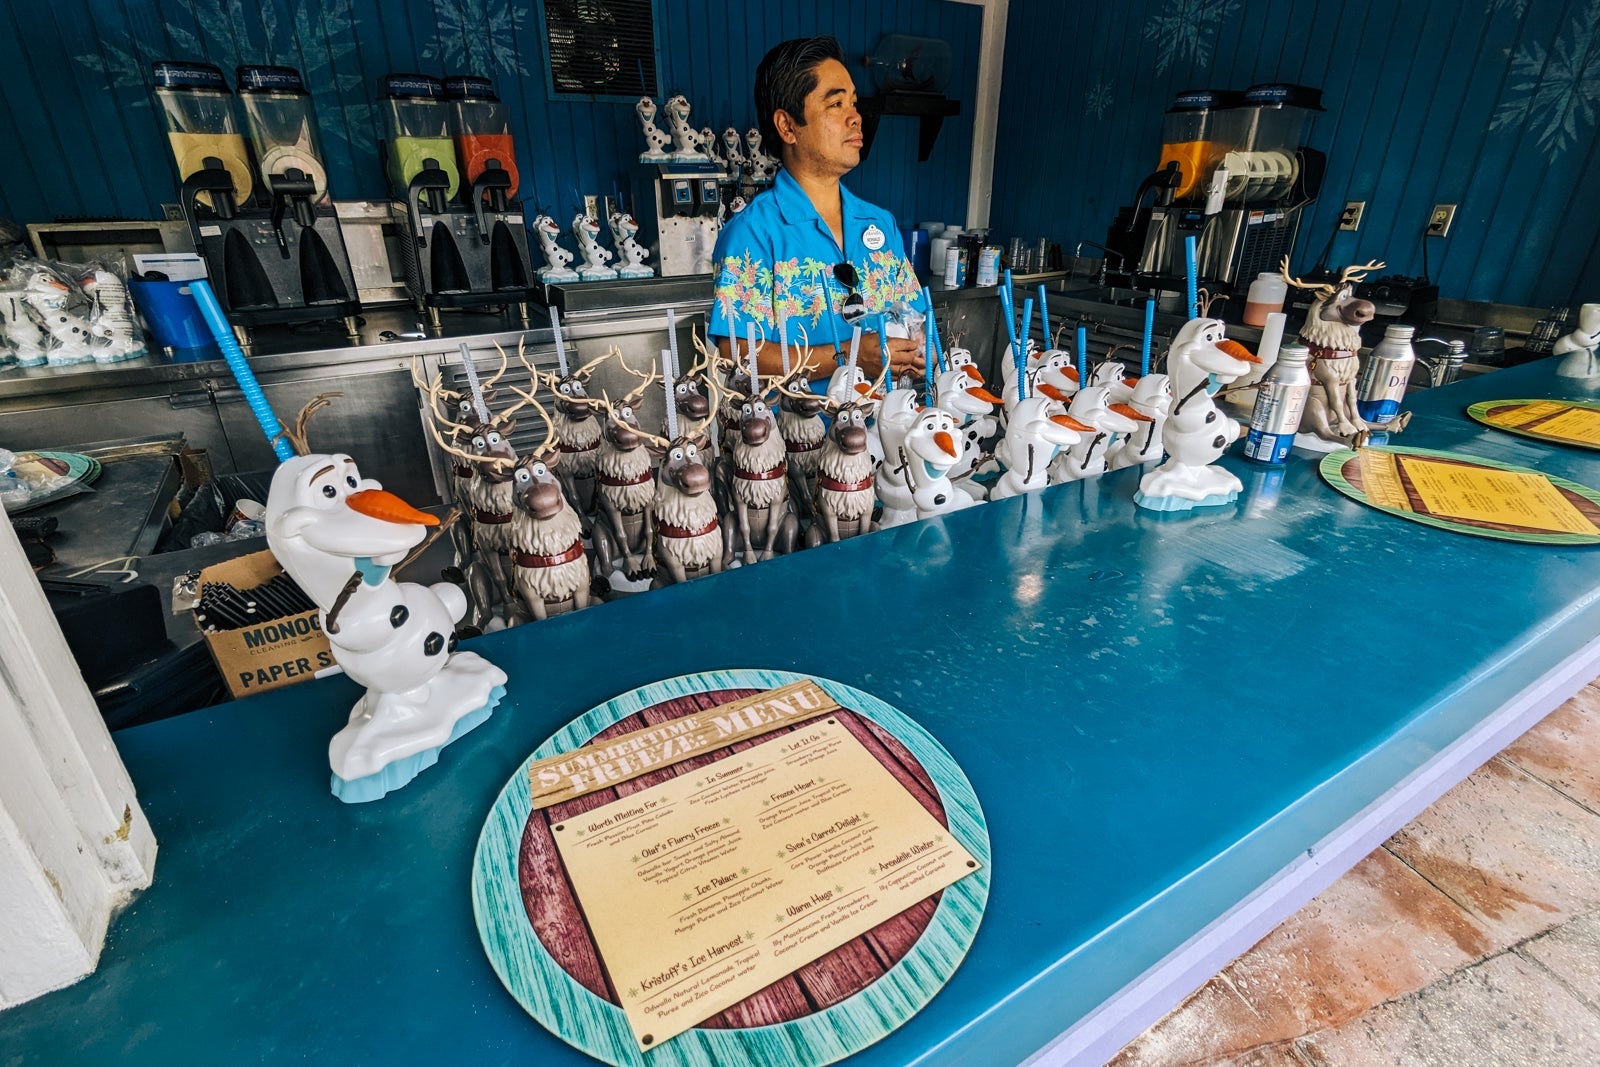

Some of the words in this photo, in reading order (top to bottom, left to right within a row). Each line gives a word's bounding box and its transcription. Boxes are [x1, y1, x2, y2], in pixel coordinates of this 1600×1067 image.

[250, 640, 297, 655] CLEANING
[240, 657, 312, 688] PAPER
[316, 650, 333, 667] S
[709, 688, 822, 737] MENU
[538, 717, 701, 787] SUMMERTIME
[788, 742, 801, 750] Let
[705, 776, 716, 784] In
[716, 766, 743, 779] Summer
[770, 790, 795, 801] Frozen
[794, 779, 816, 791] Heart
[588, 819, 613, 832] Worth
[614, 808, 644, 822] Melting
[644, 801, 657, 809] For
[587, 839, 603, 848] Fresh
[609, 838, 620, 846] and
[642, 843, 666, 857] Olaf's
[667, 833, 695, 847] Flurry
[694, 822, 720, 835] Freeze
[786, 837, 811, 852] Sven's
[811, 826, 836, 841] Carrot
[835, 815, 861, 830] Delight
[655, 872, 679, 885] Tropical
[720, 846, 737, 856] Water
[685, 853, 705, 864] Orange
[879, 852, 911, 871] Arendelle
[910, 841, 934, 854] Winter
[694, 885, 711, 896] Ice
[710, 873, 738, 887] Palace
[675, 923, 695, 935] Mango
[717, 905, 728, 914] and
[742, 888, 764, 902] Coconut
[766, 880, 783, 890] Water
[680, 912, 697, 923] Fresh
[722, 887, 750, 902] Pineapple
[786, 902, 812, 916] Warm
[810, 891, 833, 904] Hugs
[821, 910, 837, 921] Fresh
[774, 941, 798, 957] Coconut
[799, 931, 819, 943] Cream
[820, 923, 830, 932] and
[860, 899, 878, 911] Cream
[641, 963, 687, 991] Kristoff's
[688, 955, 706, 968] Ice
[707, 935, 743, 958] Harvest
[644, 998, 672, 1014] Odwalla
[673, 981, 699, 999] Natural
[735, 950, 760, 966] Tropical
[657, 1006, 679, 1018] Puree
[681, 996, 693, 1007] and
[694, 991, 709, 1000] Zico
[710, 975, 735, 991] Coconut
[737, 965, 756, 976] water
